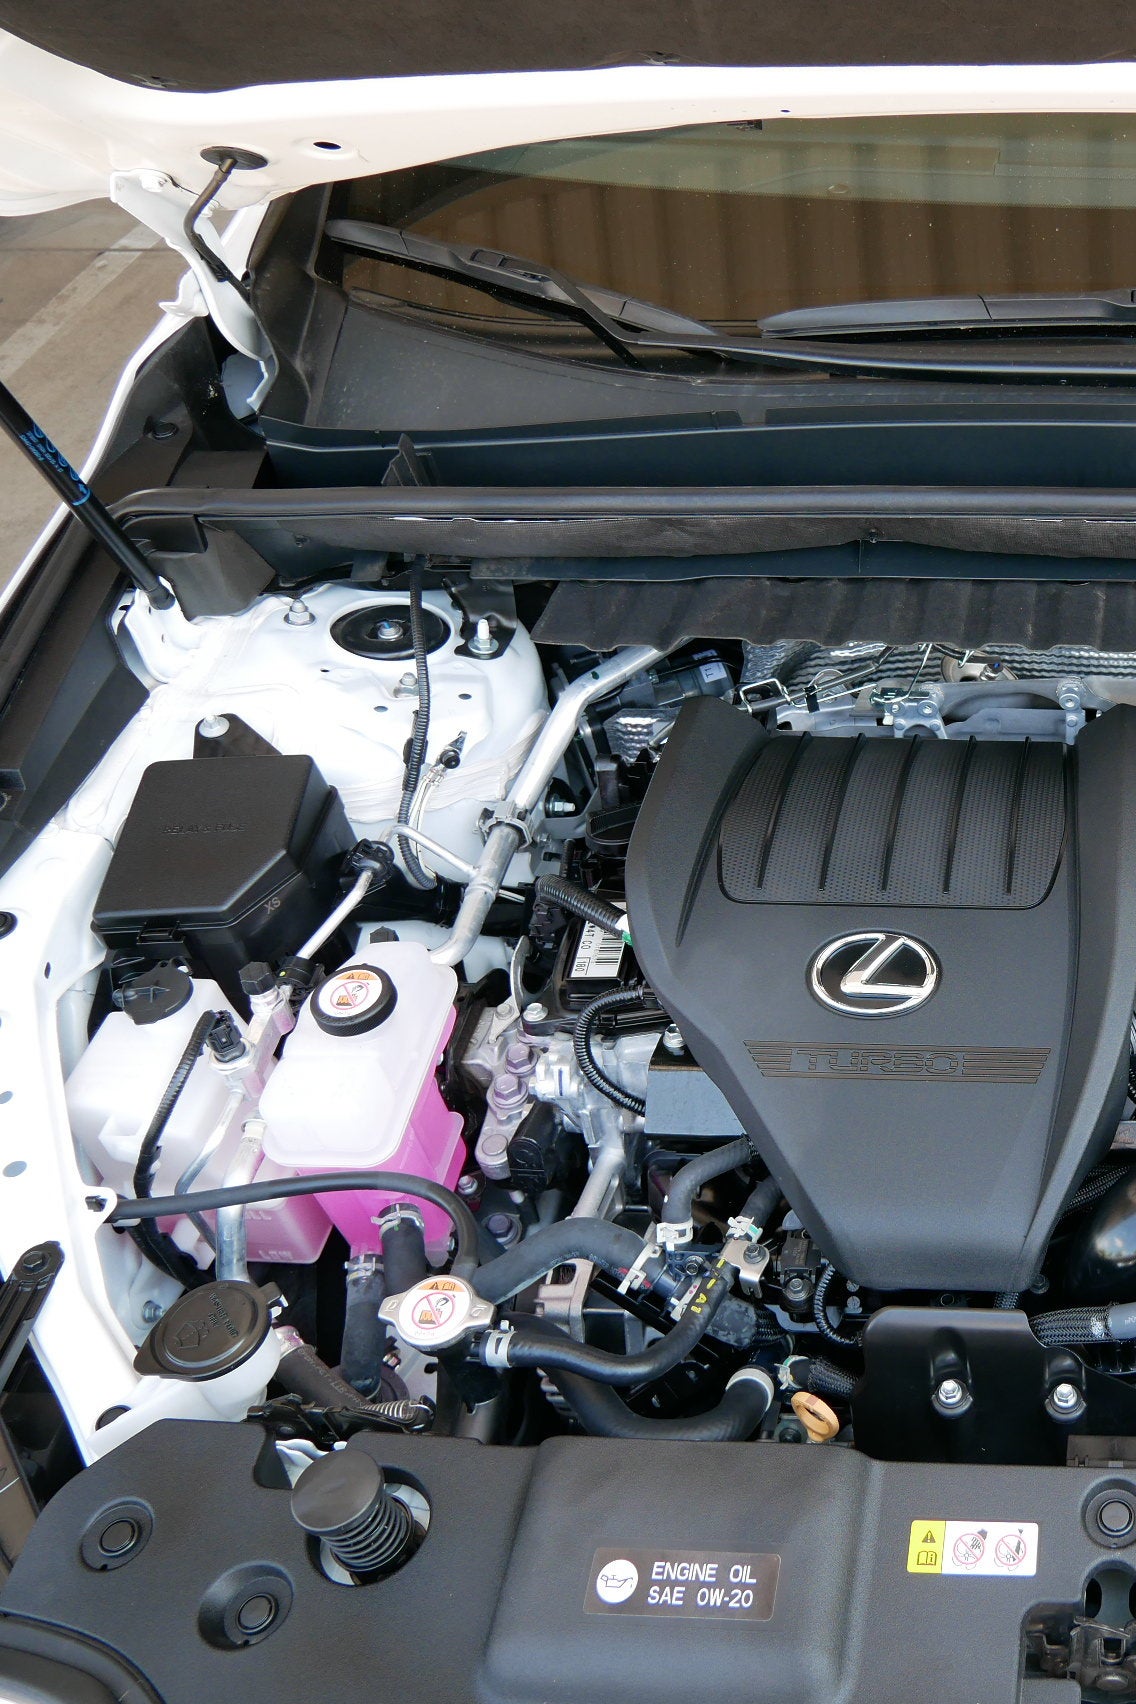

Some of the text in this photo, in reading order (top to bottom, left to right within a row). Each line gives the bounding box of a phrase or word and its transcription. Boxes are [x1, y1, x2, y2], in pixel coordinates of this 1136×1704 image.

[796, 1050, 959, 1075] TURBO
[651, 1561, 757, 1584] ENGINE OIL
[647, 1585, 754, 1608] SAE 0W-20
